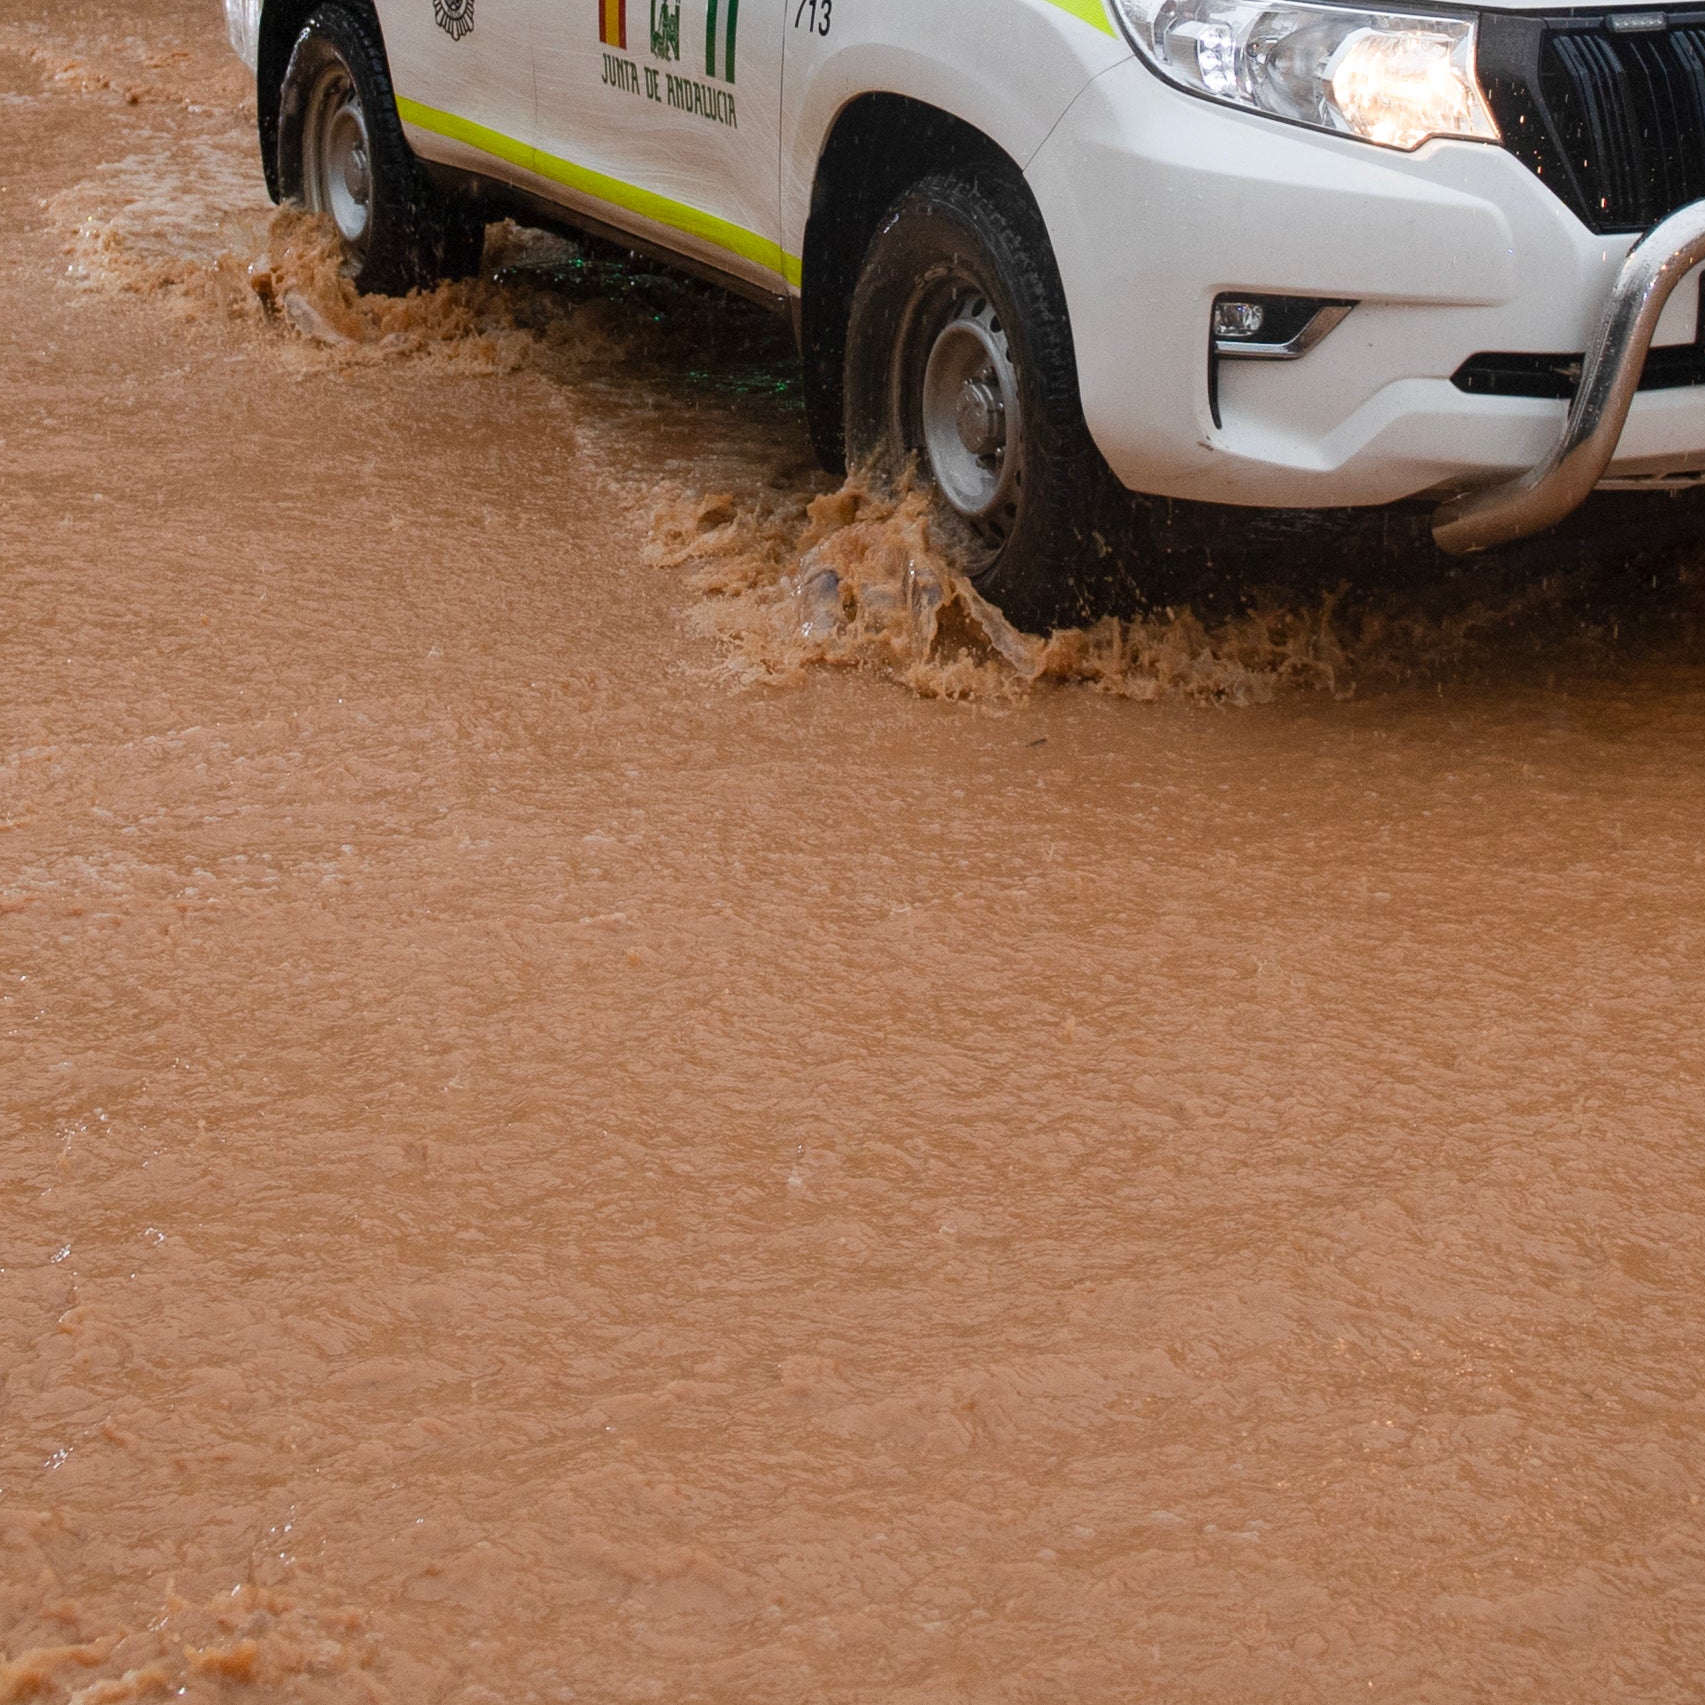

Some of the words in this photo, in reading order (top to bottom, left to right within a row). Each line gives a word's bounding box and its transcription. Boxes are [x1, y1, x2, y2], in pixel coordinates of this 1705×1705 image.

[601, 53, 640, 95] JUNTA
[644, 65, 662, 103] DE
[665, 73, 738, 129] ANDALUCIA
